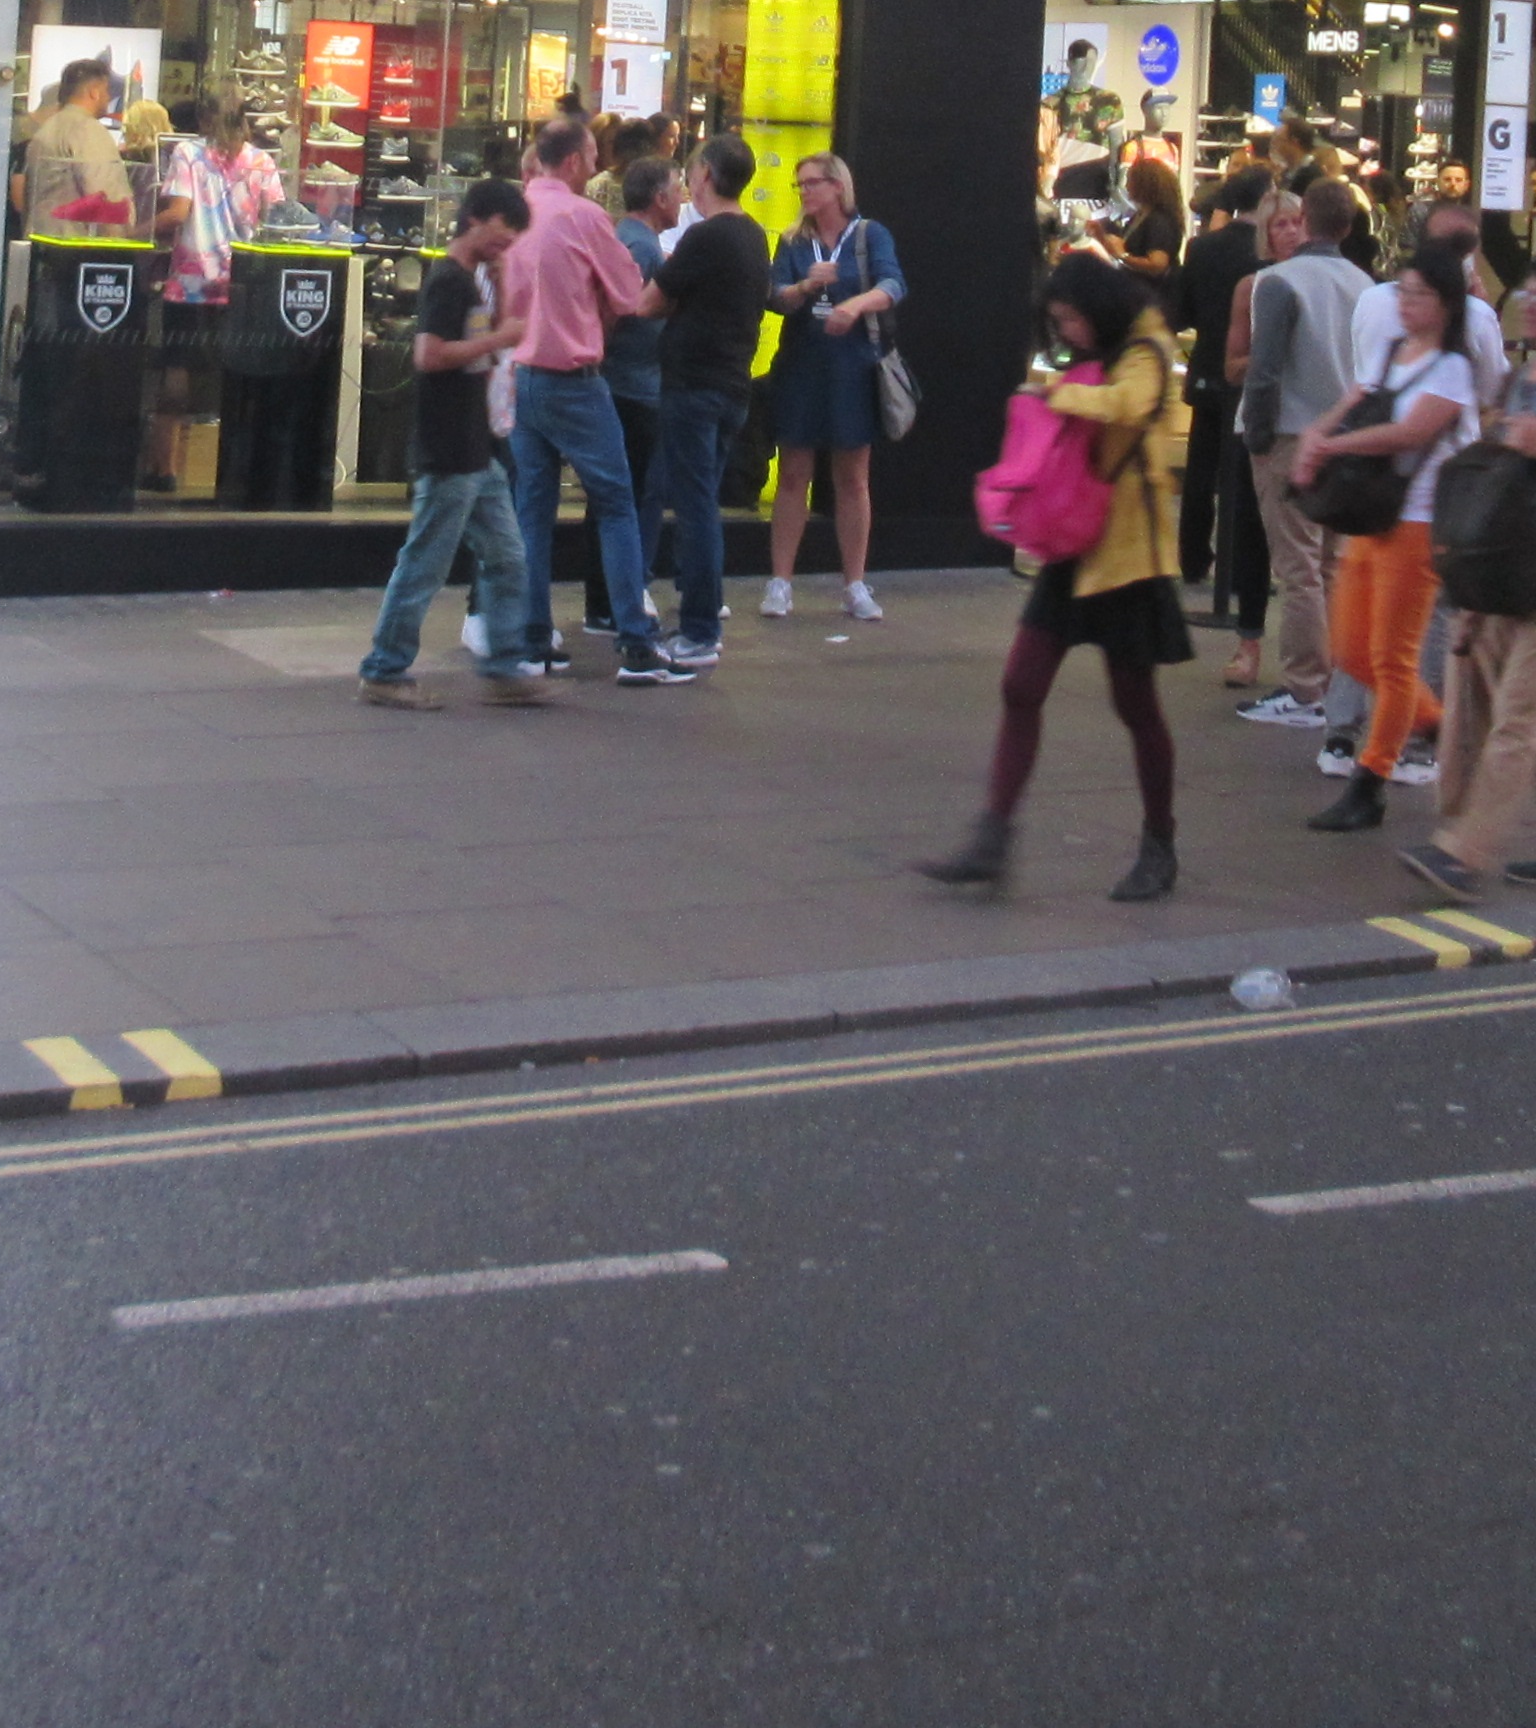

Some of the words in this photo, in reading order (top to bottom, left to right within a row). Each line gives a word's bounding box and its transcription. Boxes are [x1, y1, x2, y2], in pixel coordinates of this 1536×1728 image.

[1307, 30, 1359, 53] MENS
[1493, 12, 1507, 44] 1
[610, 58, 629, 96] 1
[1488, 118, 1511, 150] G
[84, 284, 126, 299] KING
[285, 290, 325, 303] KING
